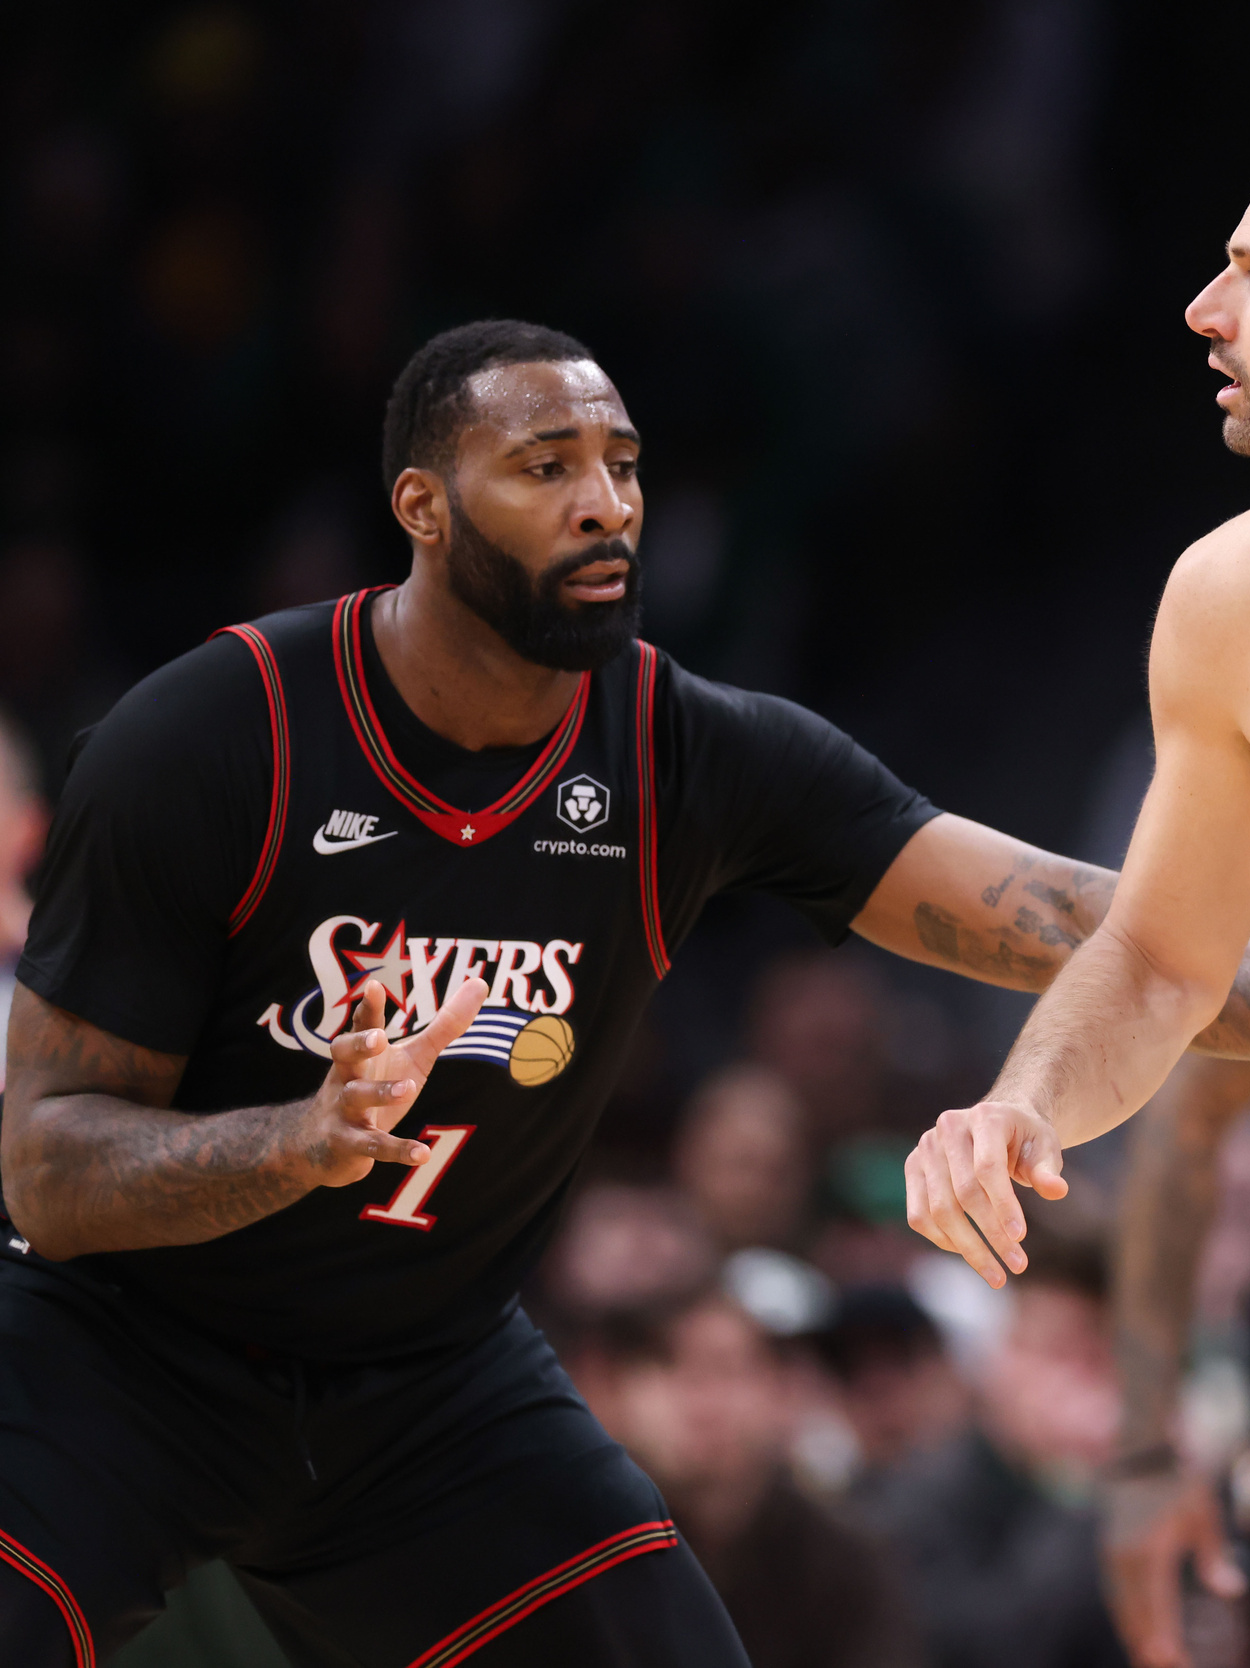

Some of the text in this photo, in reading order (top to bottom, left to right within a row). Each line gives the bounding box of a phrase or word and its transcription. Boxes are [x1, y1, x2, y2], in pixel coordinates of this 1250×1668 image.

[324, 809, 380, 840] NIKE
[533, 839, 627, 859] crypto.com
[358, 1124, 477, 1232] 1
